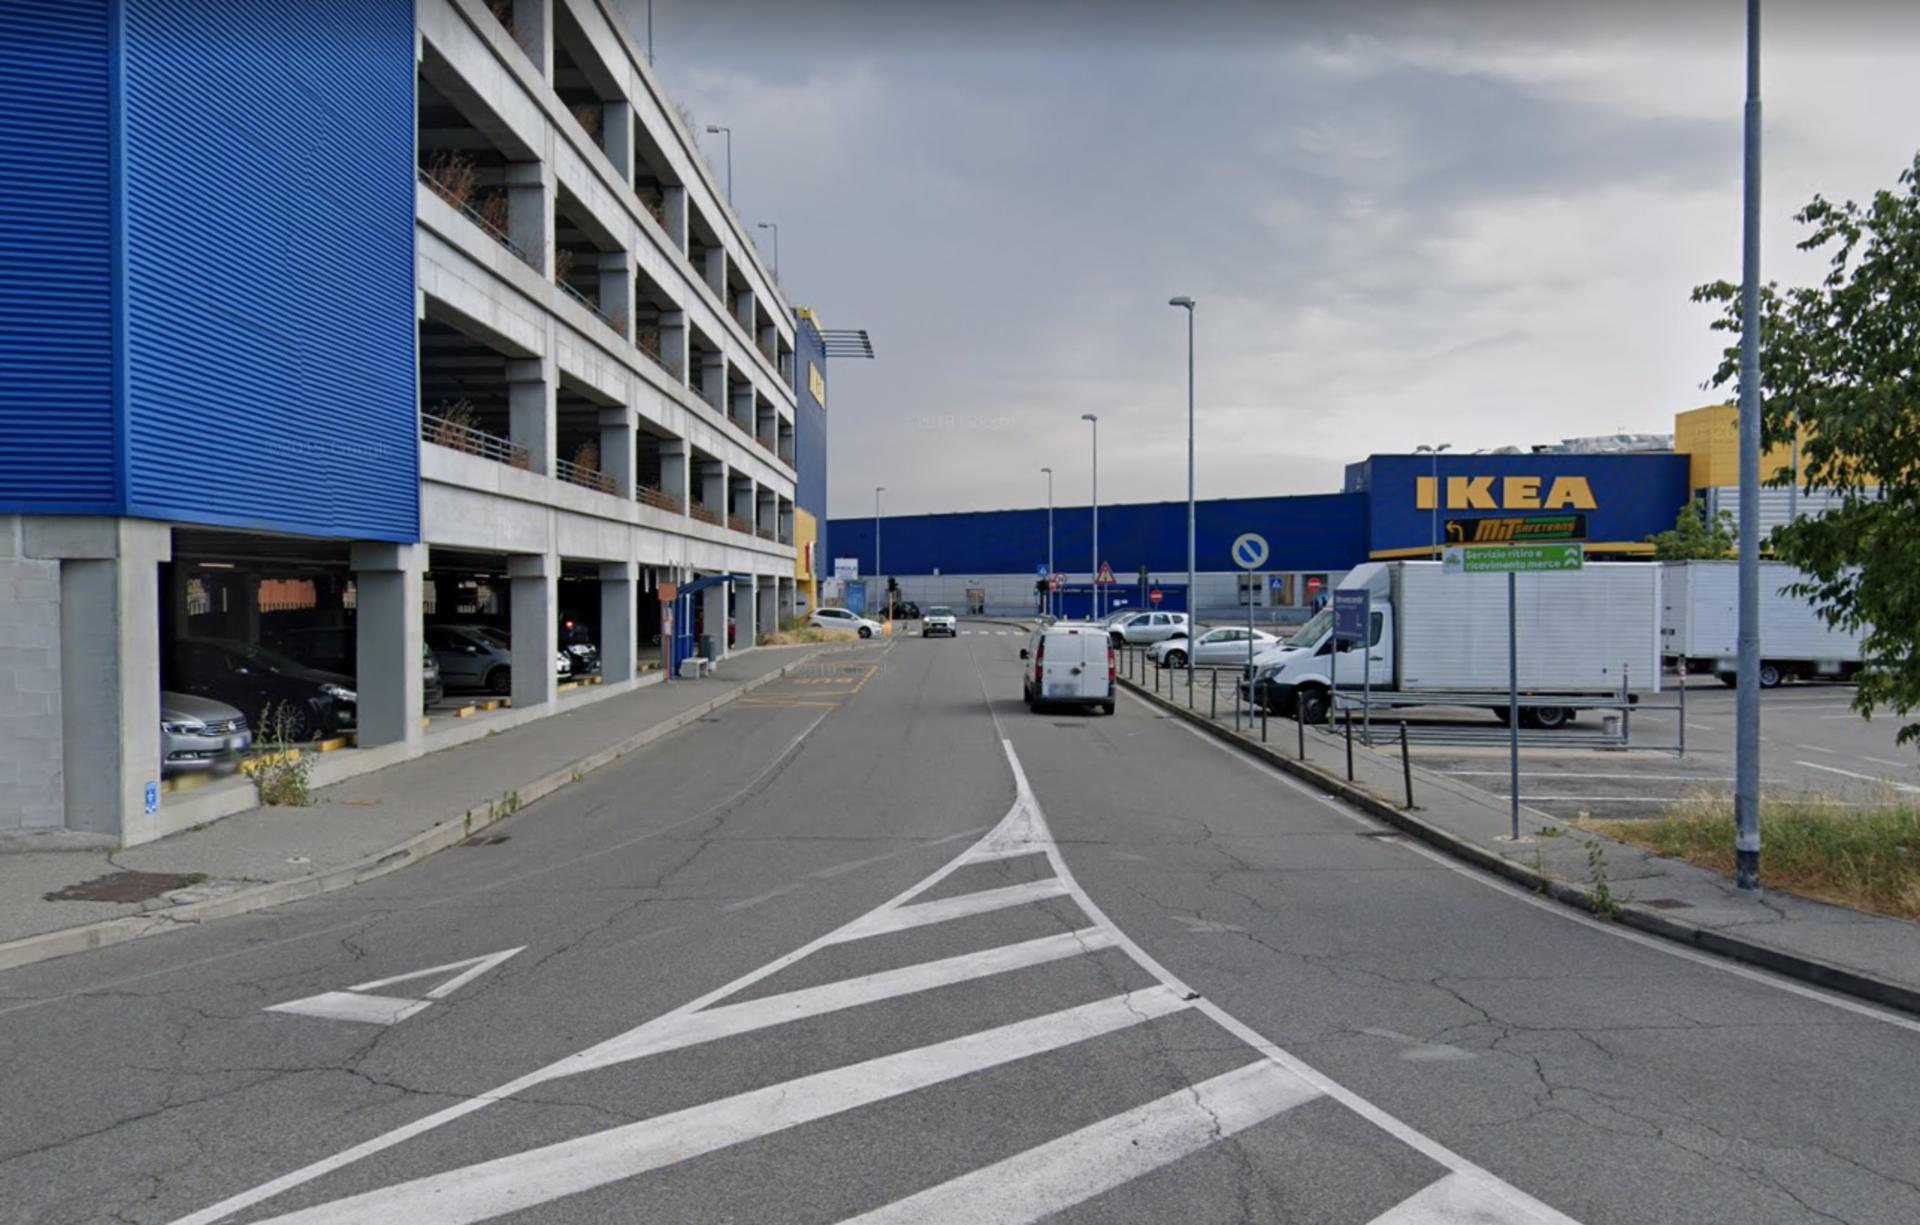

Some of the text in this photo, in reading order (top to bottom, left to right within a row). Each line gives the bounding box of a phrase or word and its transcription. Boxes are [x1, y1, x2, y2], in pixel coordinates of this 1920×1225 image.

[1416, 476, 1598, 510] IKEA
[1466, 550, 1506, 559] Servizio
[1508, 549, 1534, 558] ritiro
[1466, 560, 1561, 570] ricevimento merce
